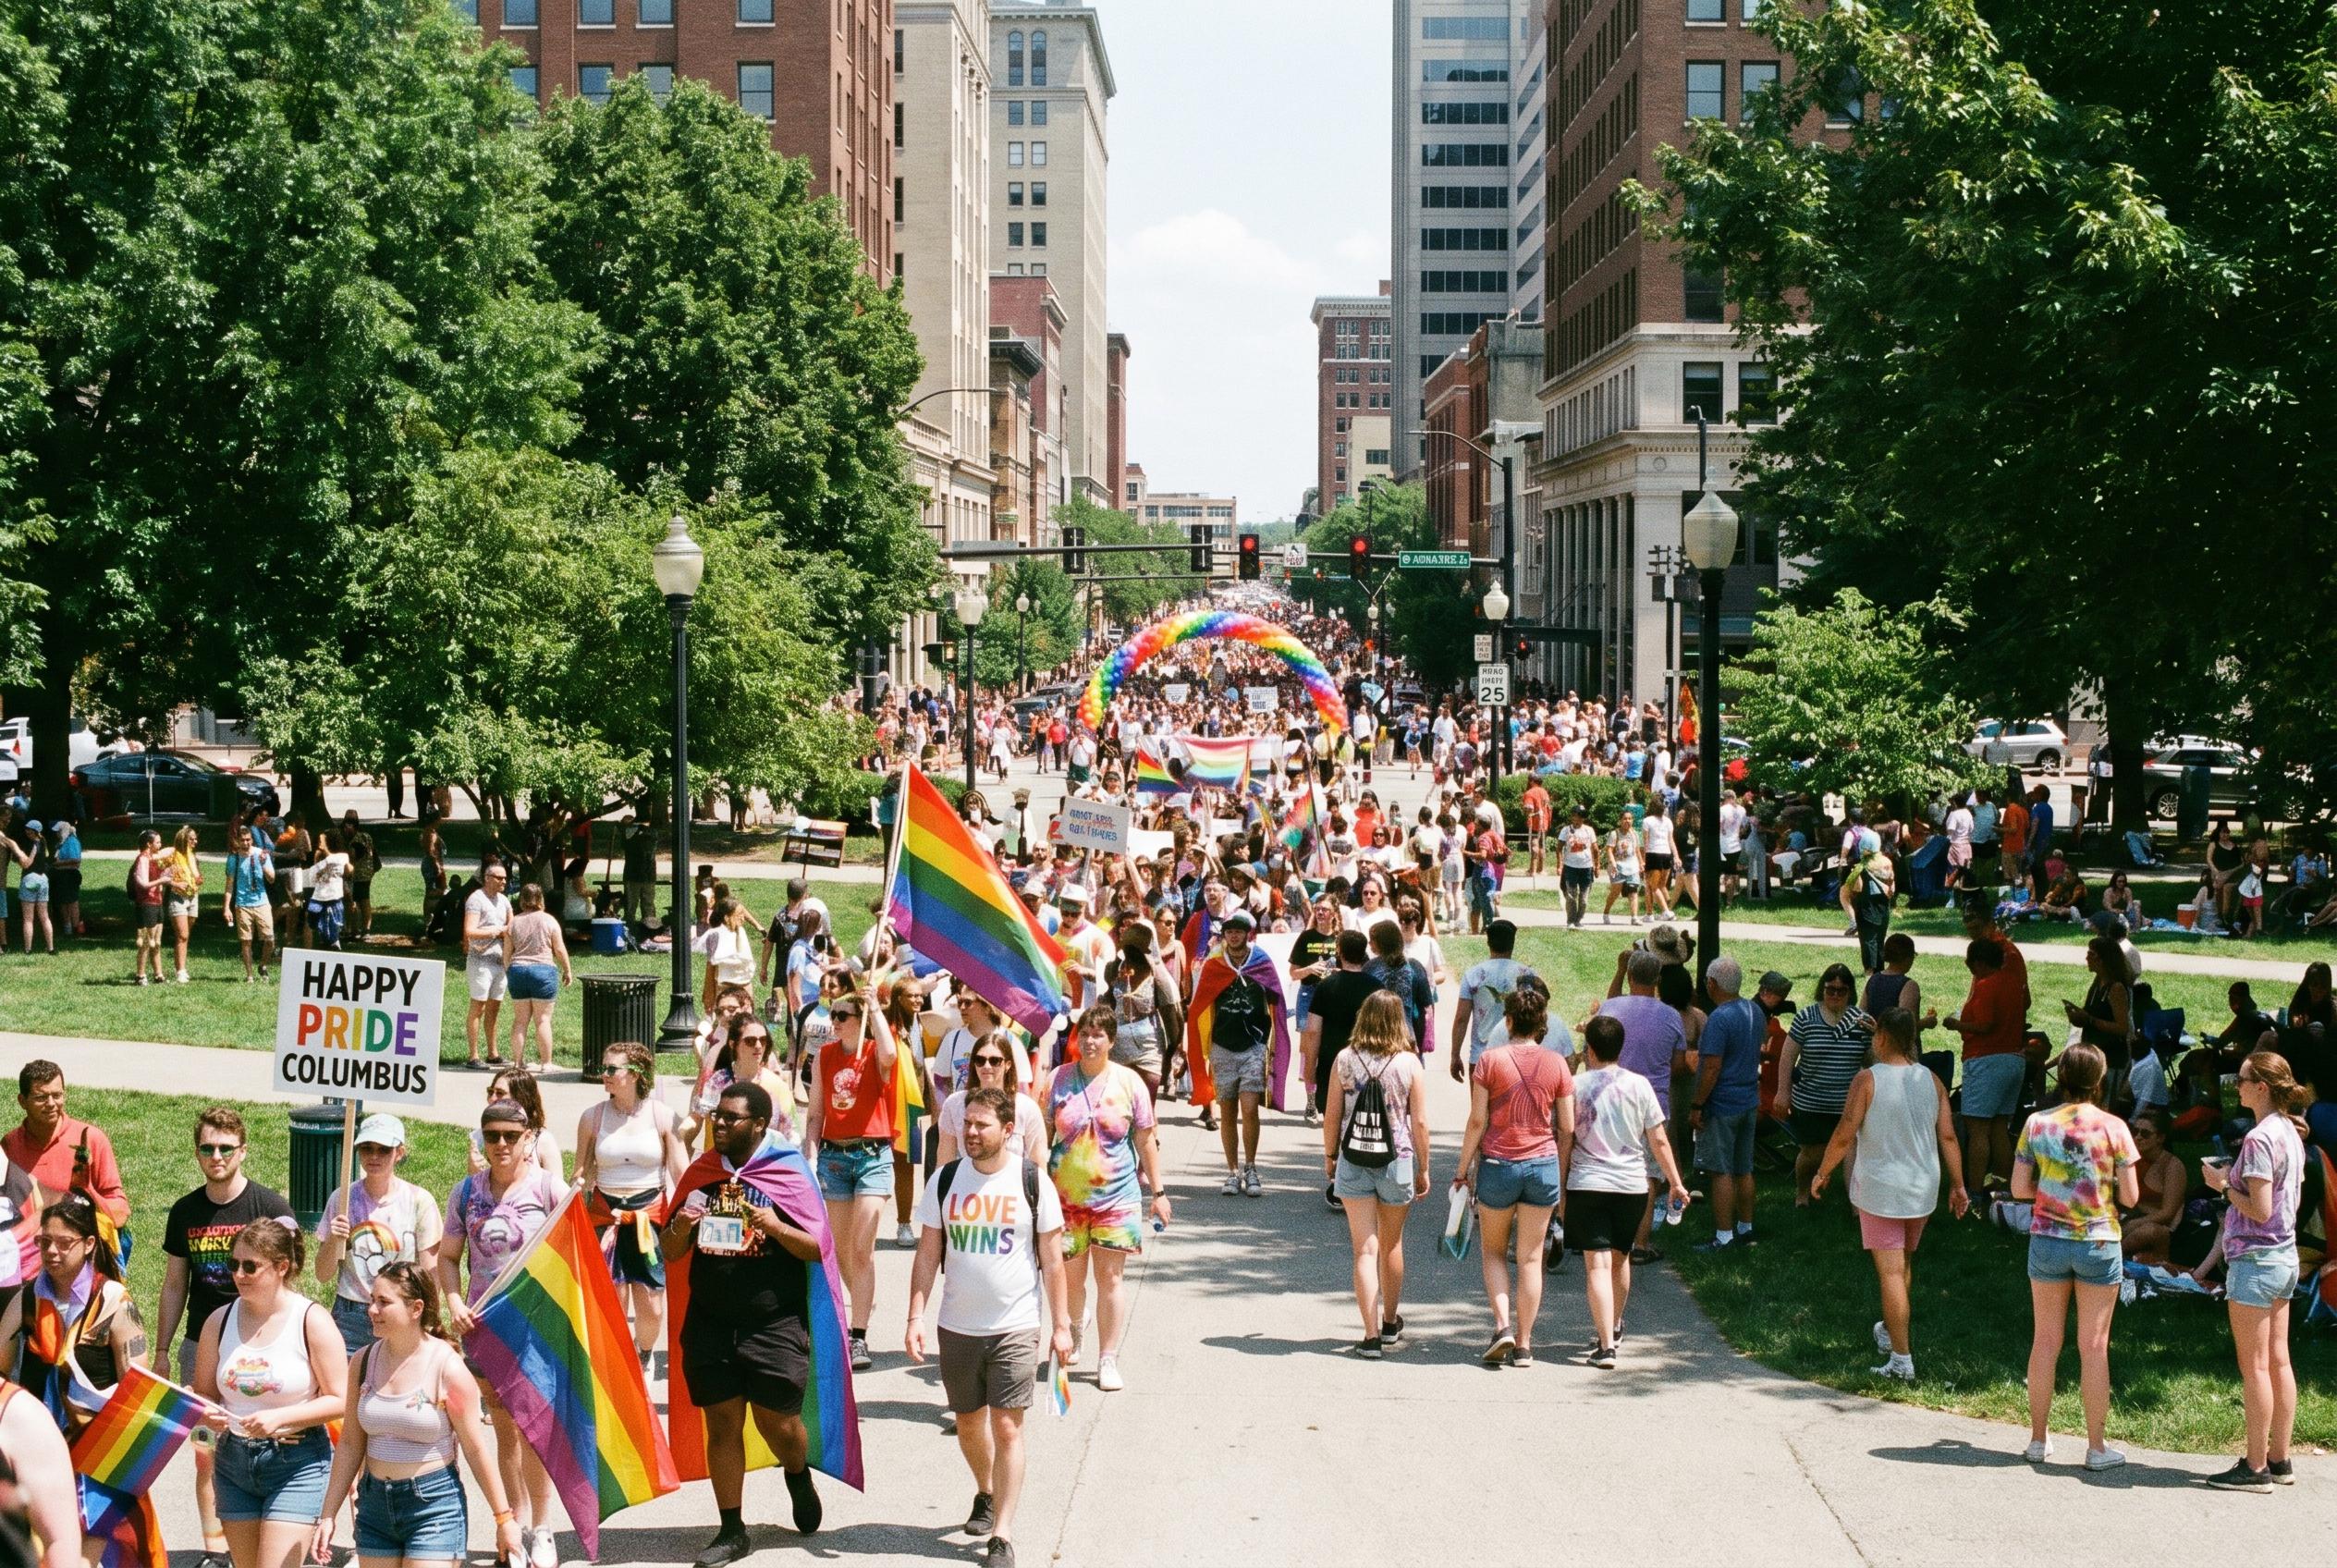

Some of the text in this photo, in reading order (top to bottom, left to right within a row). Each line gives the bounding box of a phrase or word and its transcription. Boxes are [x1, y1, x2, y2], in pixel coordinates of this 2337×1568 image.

[1481, 687, 1505, 702] 25
[303, 961, 422, 1007] HAPPY
[298, 1003, 419, 1056] PRIDE
[282, 1052, 427, 1094] COLUMBUS
[948, 1193, 1016, 1224] LOVE
[949, 1225, 1015, 1256] WINS
